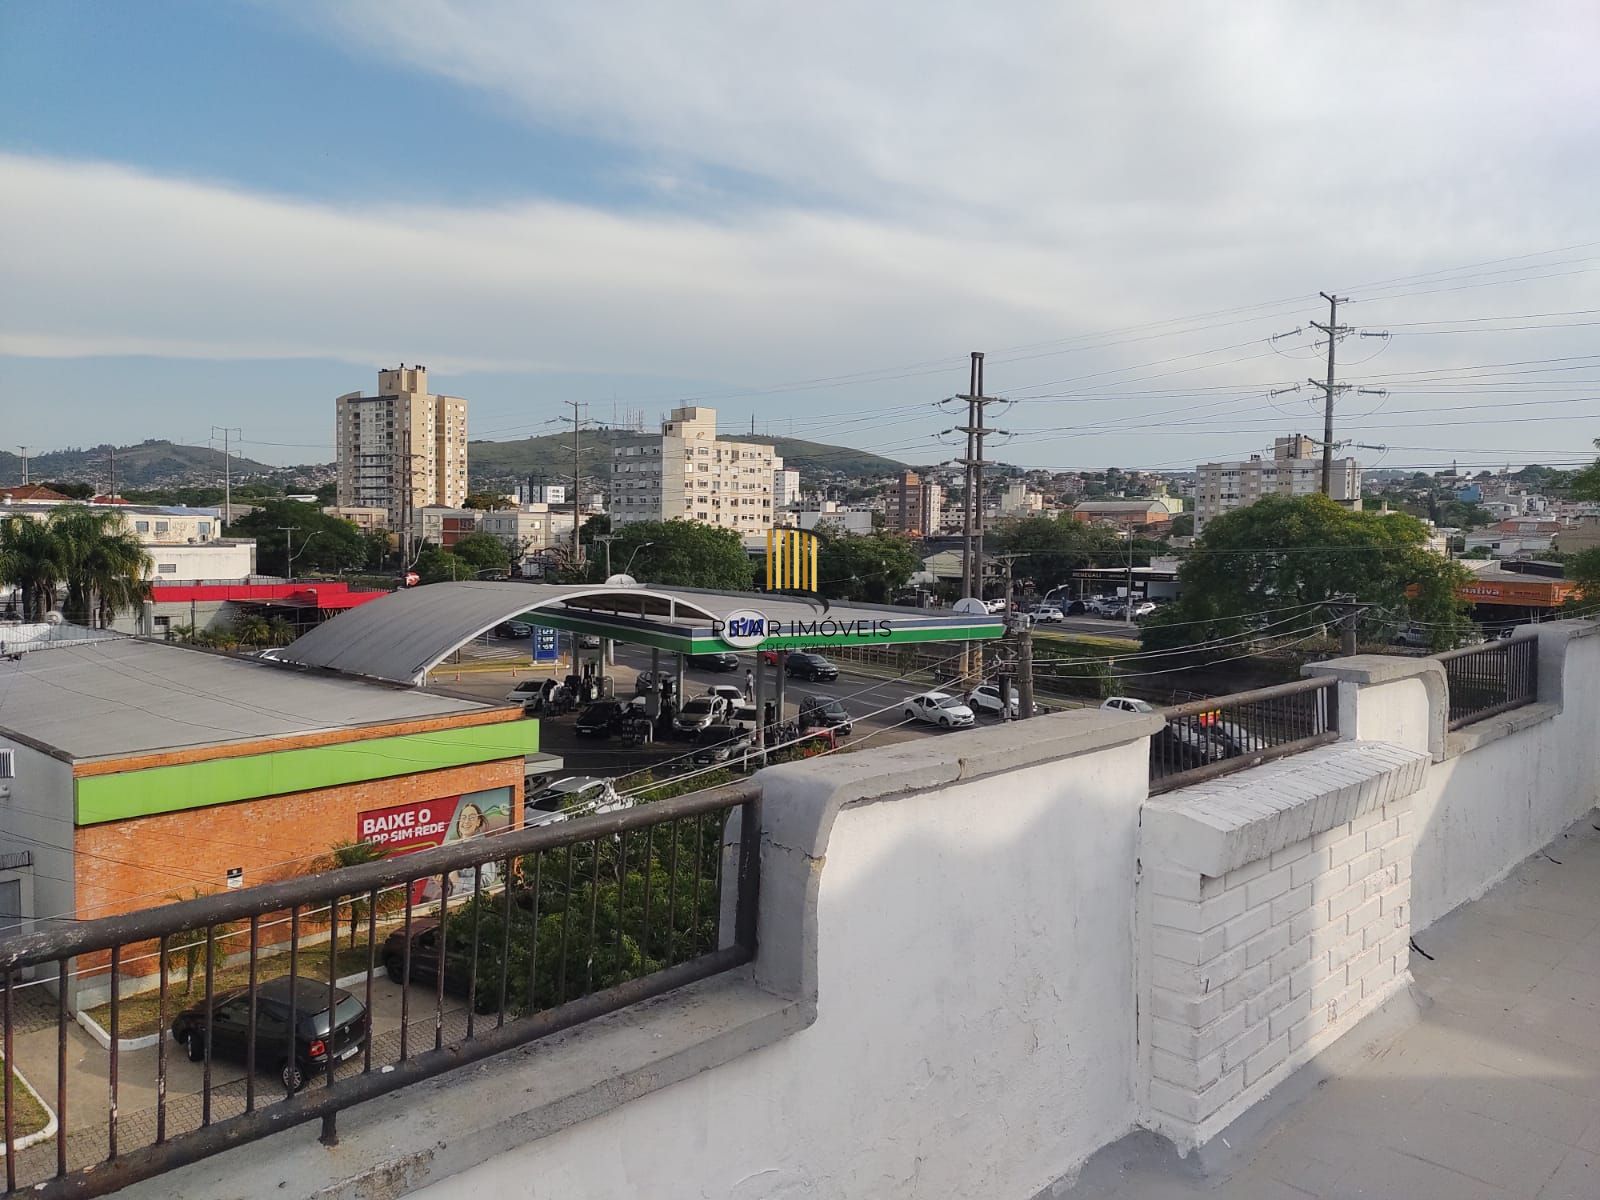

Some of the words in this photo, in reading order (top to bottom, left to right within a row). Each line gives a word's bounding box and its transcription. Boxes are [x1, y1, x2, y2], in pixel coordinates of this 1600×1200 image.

[363, 811, 415, 835] BAIXE
[418, 808, 431, 824] O
[364, 833, 389, 846] APP
[390, 828, 412, 843] SIM
[414, 822, 445, 838] REDE
